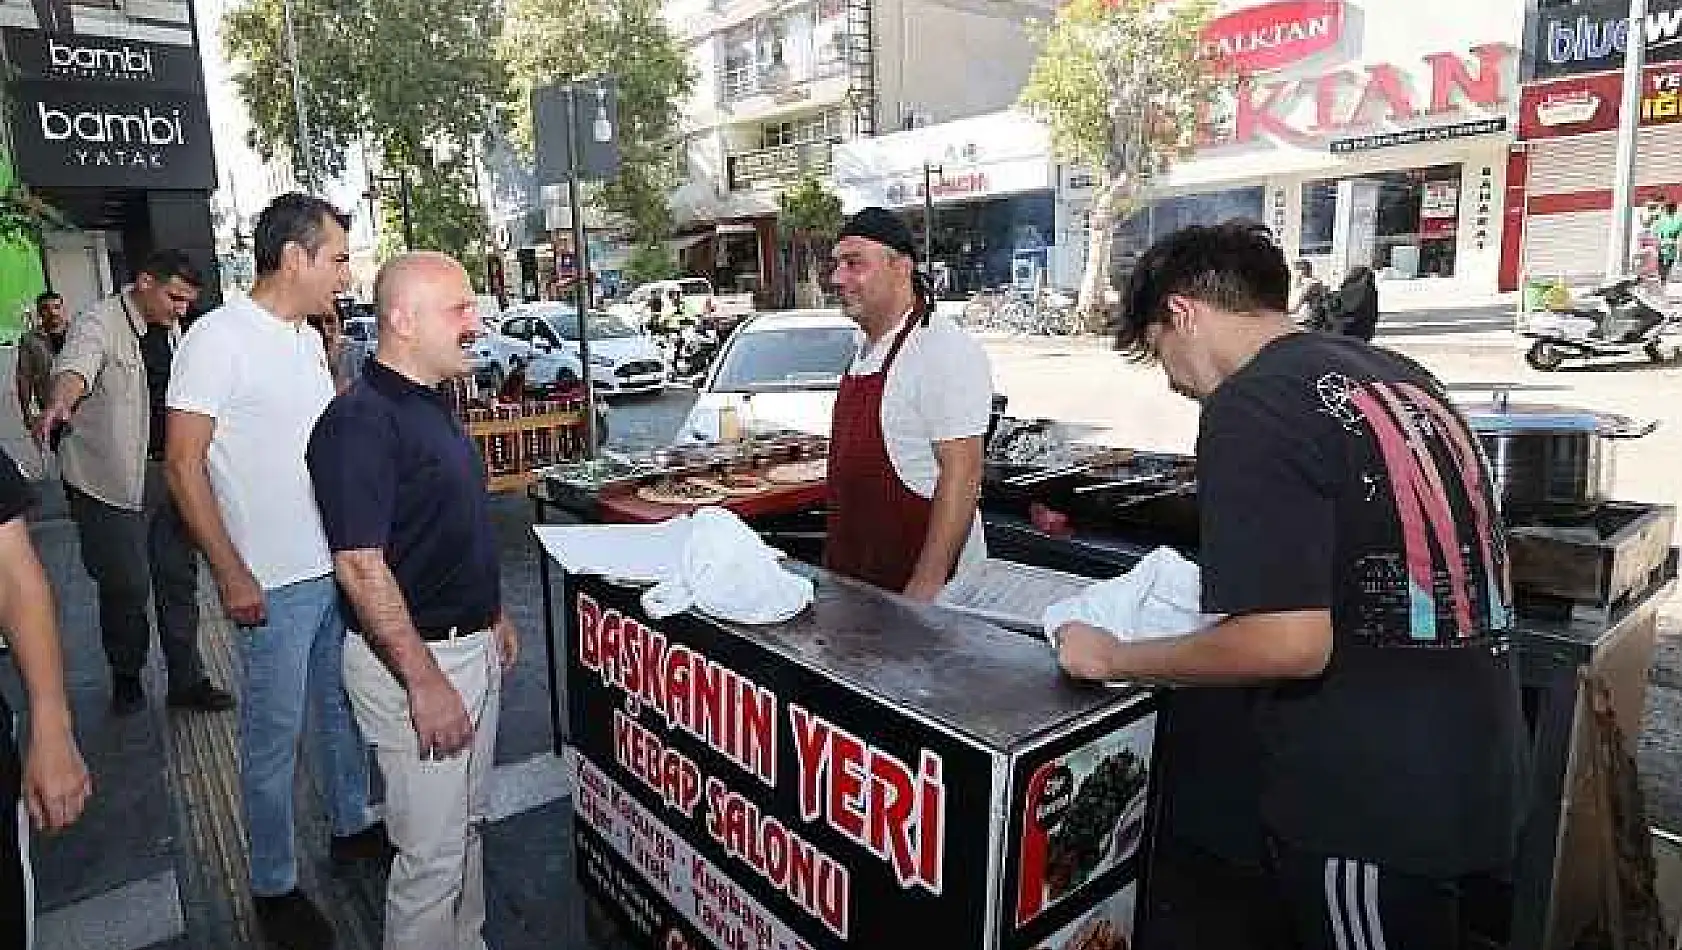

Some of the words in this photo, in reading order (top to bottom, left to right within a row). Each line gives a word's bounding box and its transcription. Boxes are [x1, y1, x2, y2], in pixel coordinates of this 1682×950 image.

[49, 38, 152, 73] bambi
[1196, 15, 1333, 60] ALKTAN
[38, 102, 185, 144] bambi
[577, 592, 778, 788] BAŞKANIN
[788, 703, 945, 894] YERİ
[613, 709, 702, 819] KEBAP
[706, 776, 849, 941] SALONU
